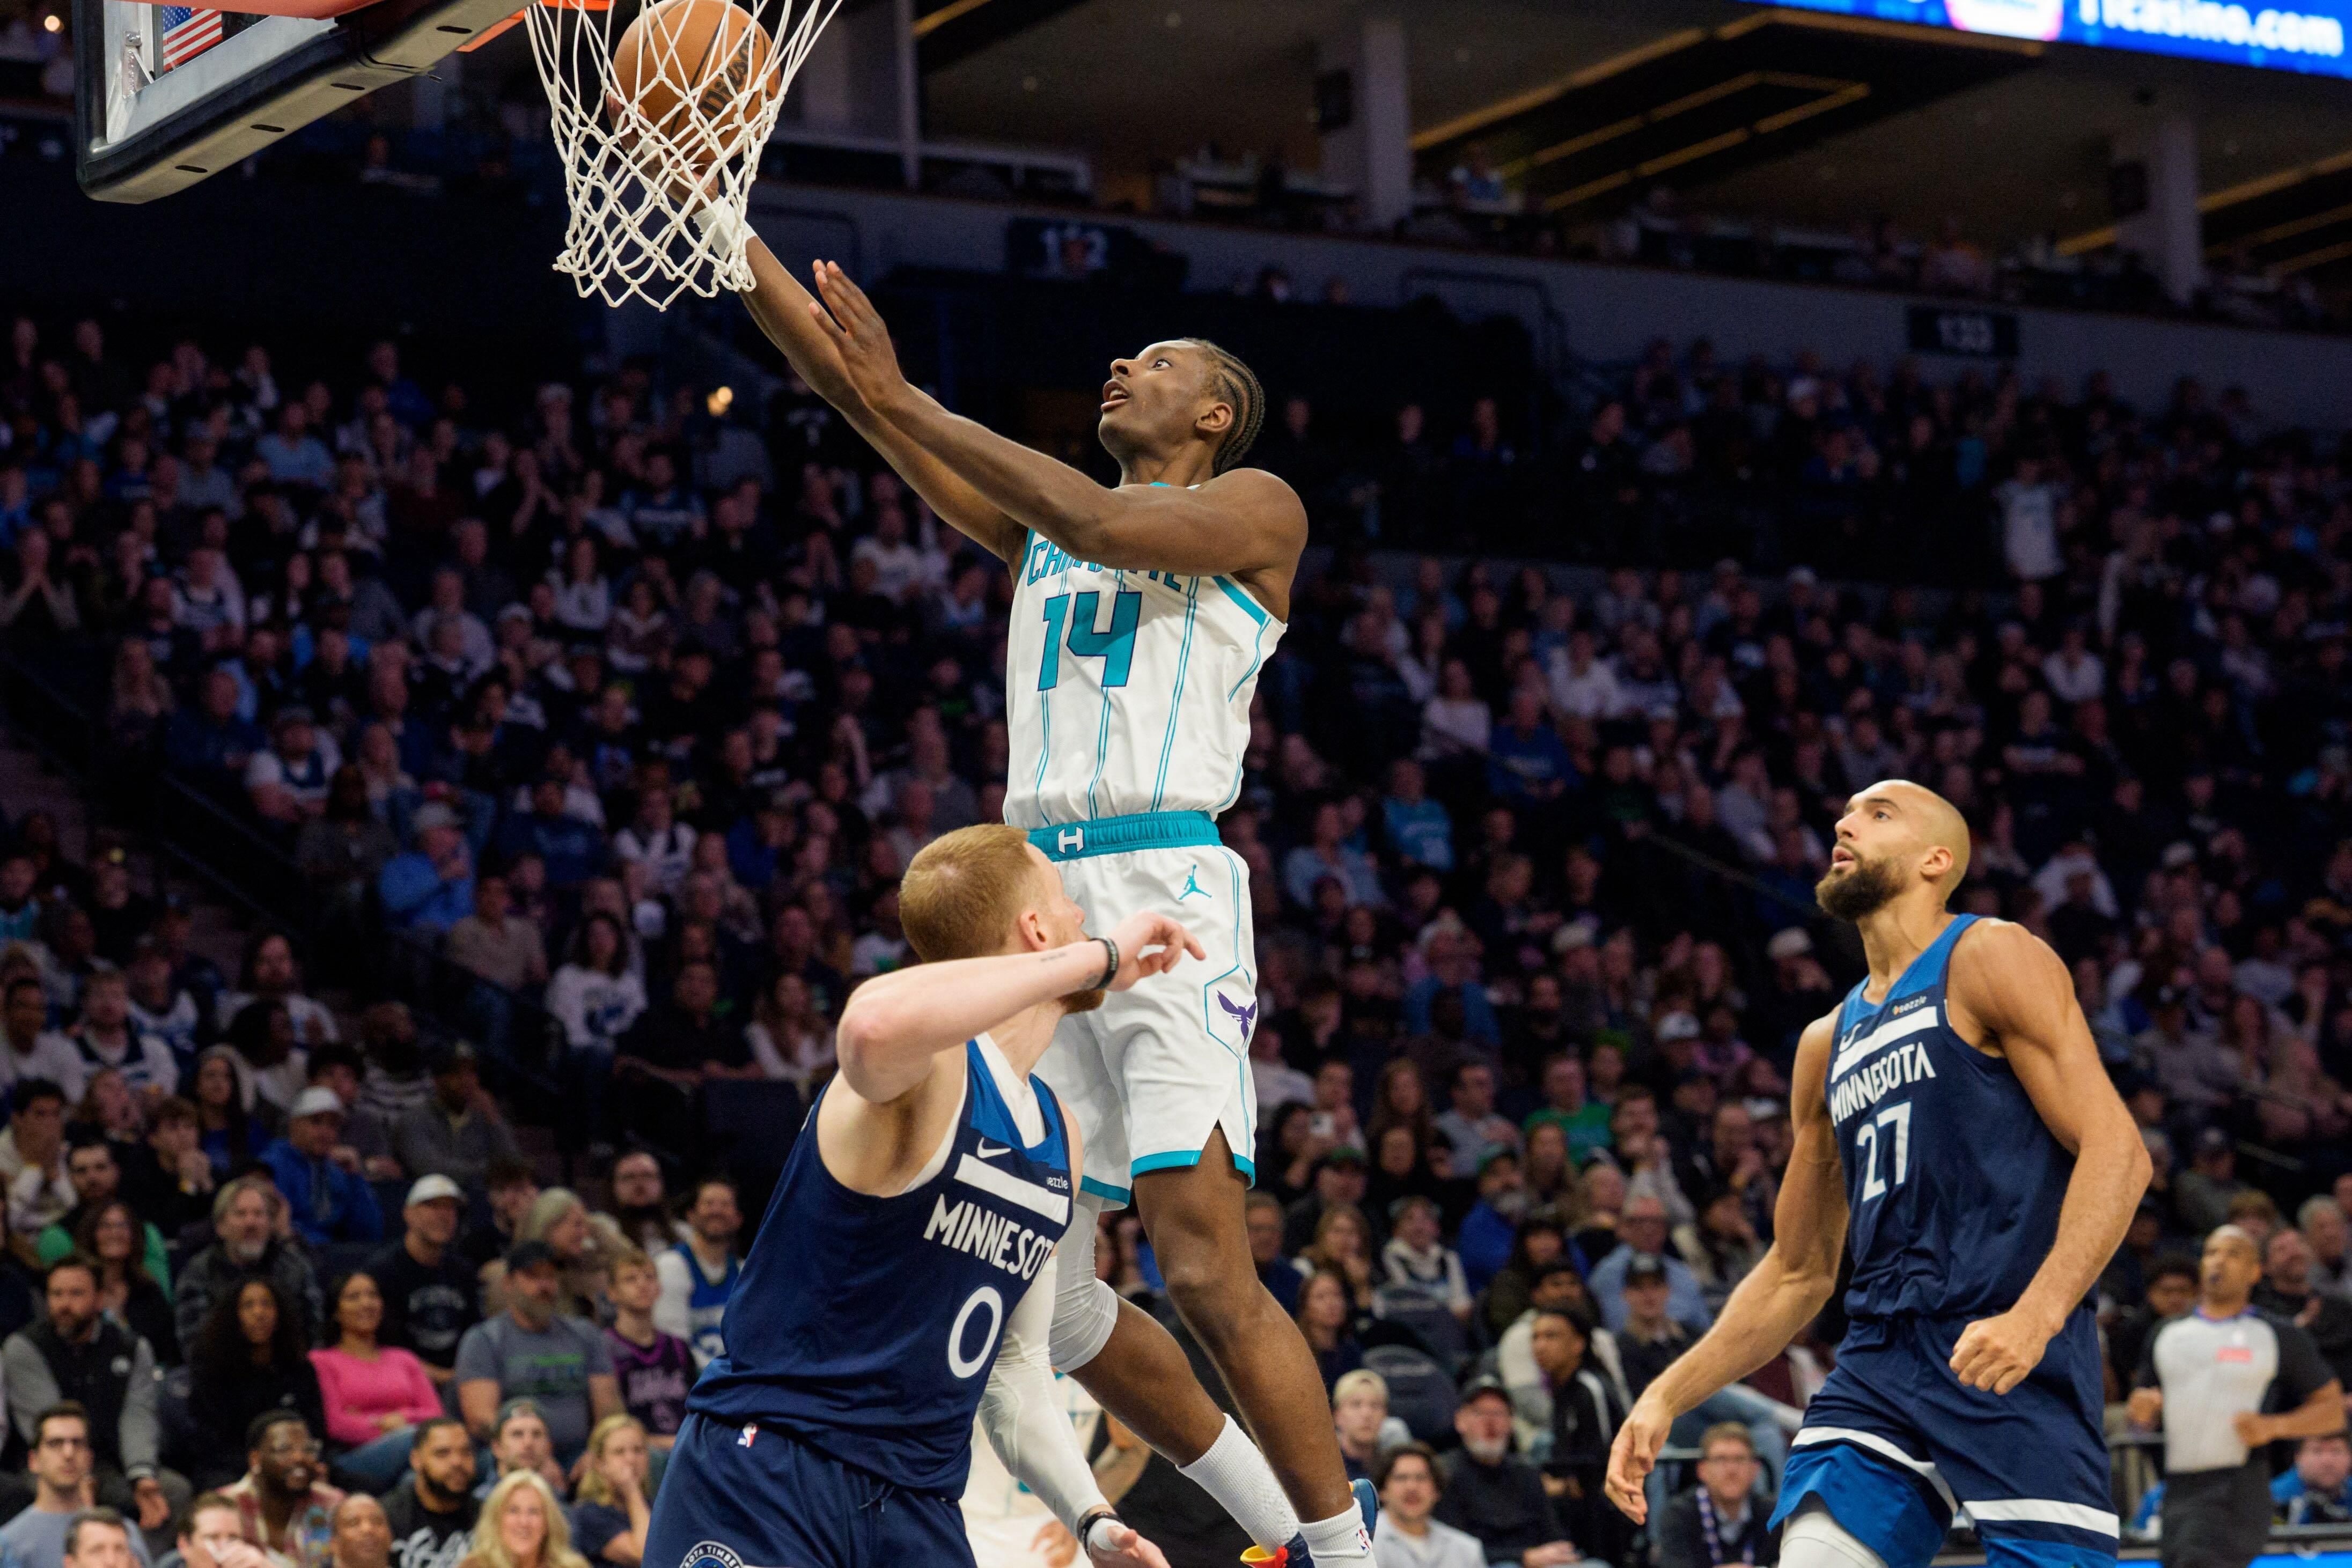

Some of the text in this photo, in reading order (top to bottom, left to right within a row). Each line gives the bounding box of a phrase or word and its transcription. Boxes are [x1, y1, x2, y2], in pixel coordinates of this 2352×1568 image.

[1038, 591, 1142, 691] 14
[1830, 1042, 1936, 1127] MINNESOTA
[1856, 1100, 1912, 1202] 27
[948, 1286, 1003, 1379] 0
